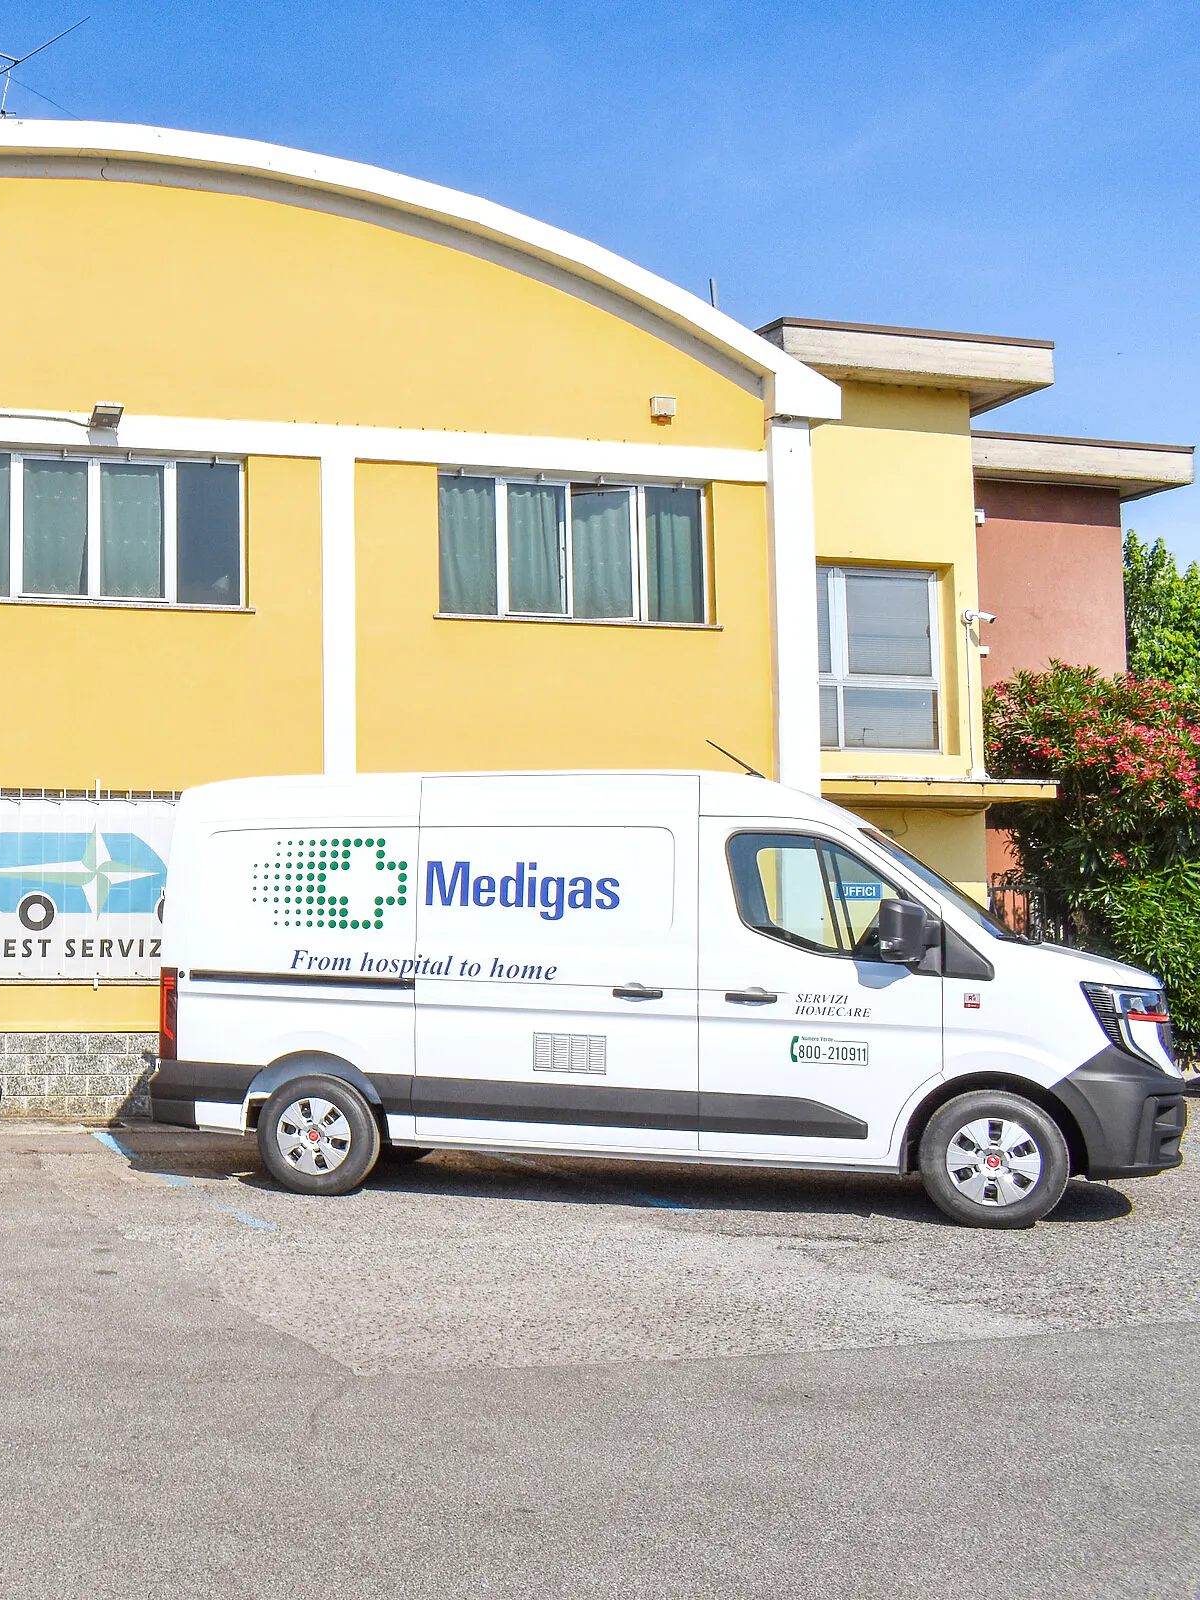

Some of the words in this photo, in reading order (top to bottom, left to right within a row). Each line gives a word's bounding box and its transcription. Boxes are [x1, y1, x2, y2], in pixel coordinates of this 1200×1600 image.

[424, 860, 621, 921] Medigas
[289, 948, 352, 972] From
[359, 950, 454, 980] hospital
[458, 959, 482, 978] to
[489, 956, 558, 981] home
[795, 992, 849, 1005] SERVIZI
[795, 1005, 872, 1018] HOMECARE
[798, 1044, 867, 1062] 800-210911
